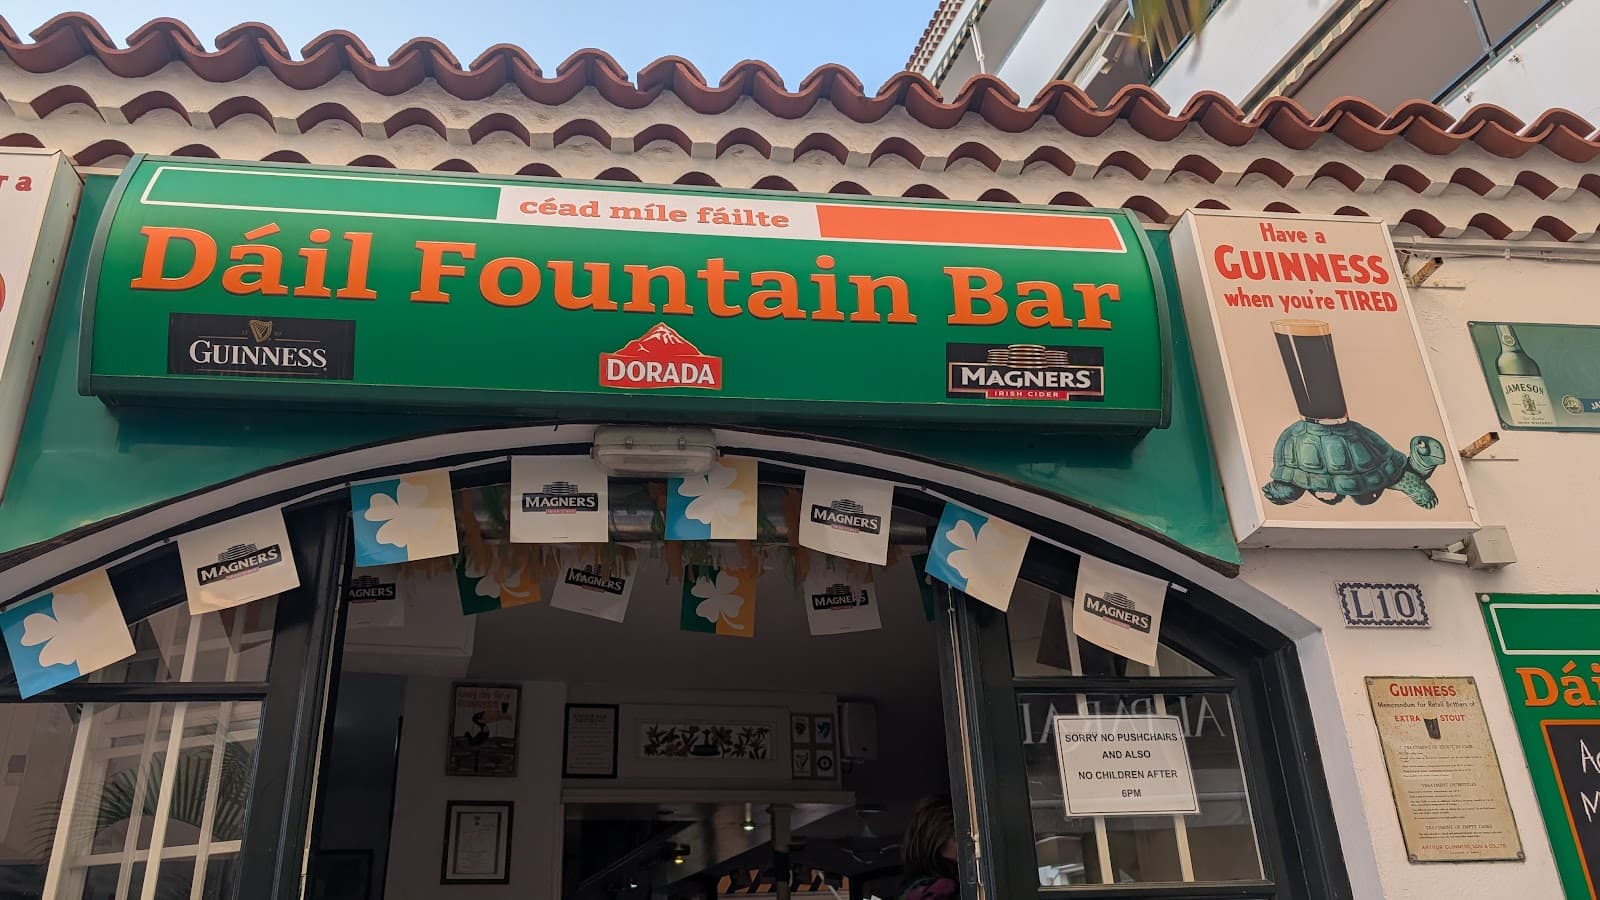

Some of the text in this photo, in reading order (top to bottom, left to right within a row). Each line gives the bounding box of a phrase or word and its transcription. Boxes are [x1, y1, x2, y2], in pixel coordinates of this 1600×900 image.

[15, 176, 32, 191] a
[519, 199, 790, 228] céad míle fáilte
[1259, 223, 1326, 244] Have a
[1213, 244, 1390, 284] GUINNESS
[130, 222, 1121, 329] Dáil Fountain Bar
[1223, 286, 1398, 313] when you're TIRED
[188, 338, 328, 369] GUINNESS
[606, 358, 716, 387] DORADA
[960, 366, 1093, 390] MAGNERS
[994, 390, 1059, 399] IRISH CIDER
[1504, 383, 1544, 395] JAMESON
[525, 495, 596, 509] MAGNERS
[813, 508, 878, 530] MAGNERS
[200, 546, 279, 583] MAGNERS
[348, 586, 394, 598] AGNERS
[1086, 596, 1151, 629] MAGNERS
[1351, 589, 1416, 620] L10
[1389, 683, 1457, 697] GUINNESS
[1394, 713, 1466, 723] EXTRA STOUT
[1064, 732, 1178, 743] SORRY NO PUSHCHAIRS
[1102, 749, 1152, 760] AND ALSO
[1078, 769, 1179, 780] NO CHILDREN AFTER
[1121, 788, 1142, 798] 6PM
